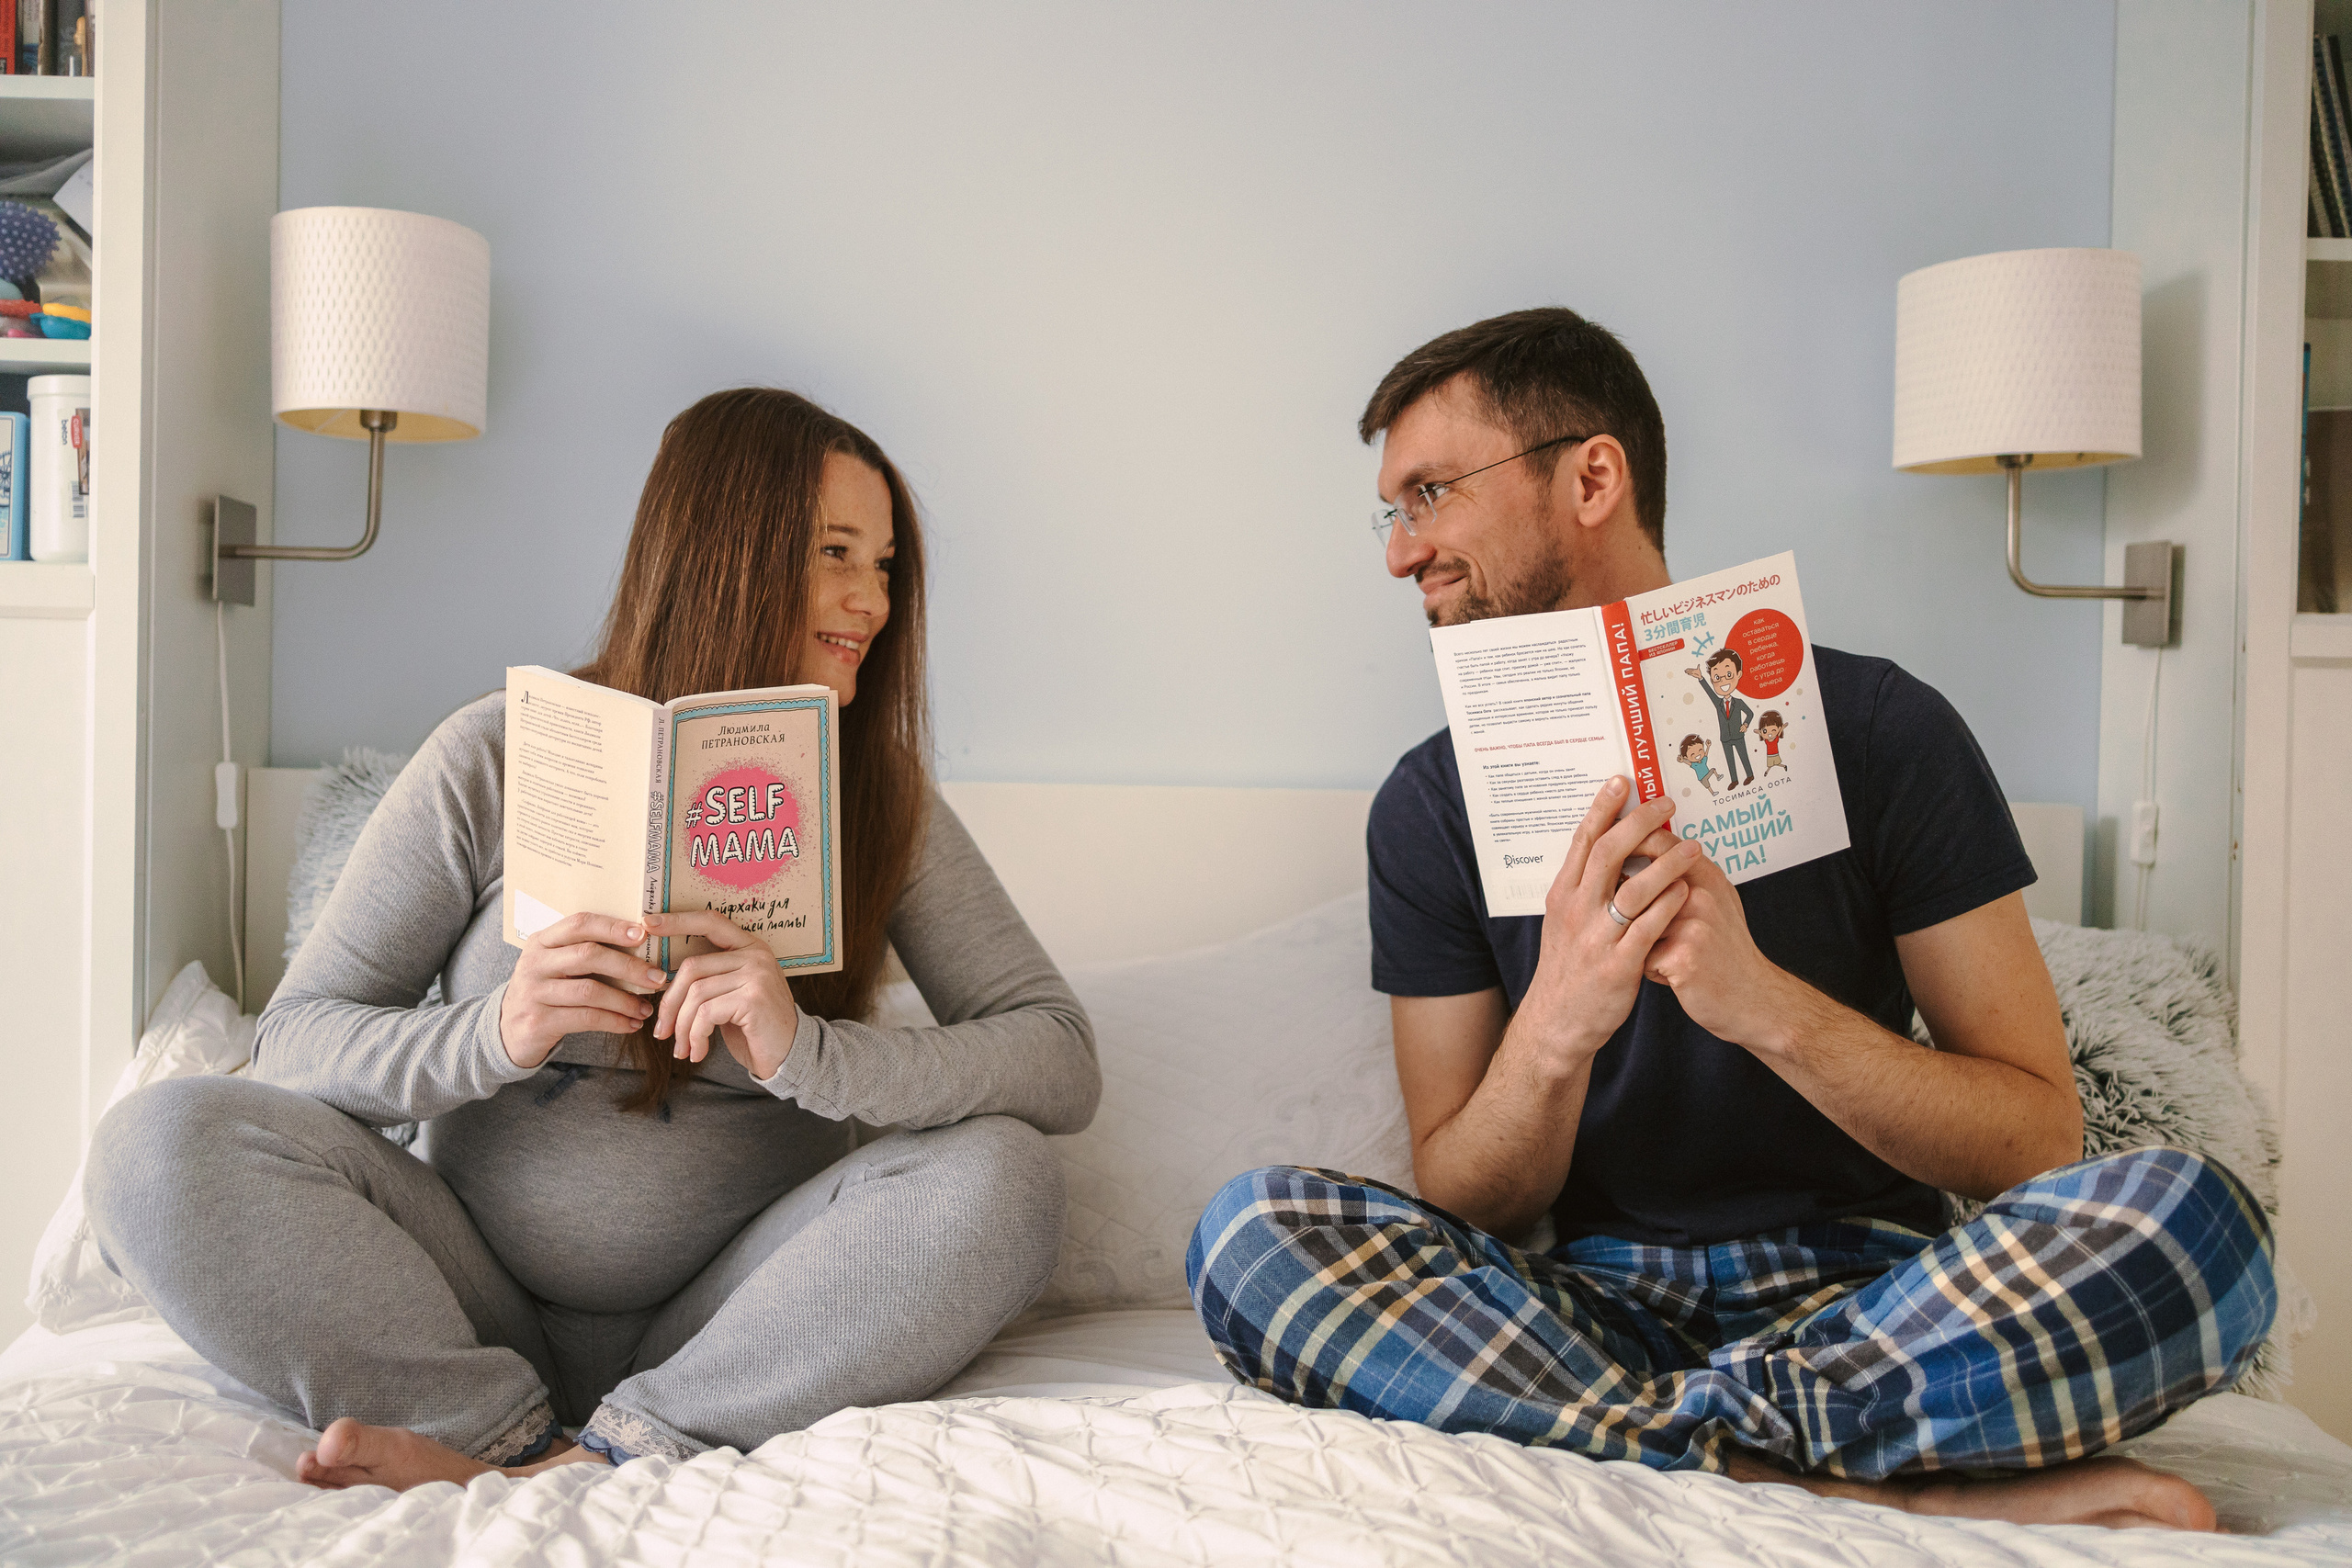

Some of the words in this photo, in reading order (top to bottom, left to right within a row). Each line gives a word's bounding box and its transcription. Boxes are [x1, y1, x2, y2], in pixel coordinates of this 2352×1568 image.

[1641, 574, 1781, 626] 忙しいビジネスマンのための
[1644, 613, 1706, 641] 3分間育児
[1743, 623, 1779, 637] оставаться
[1753, 633, 1777, 643] сердце
[1611, 622, 1634, 678] ПАПА!
[1757, 651, 1775, 660] когда
[1750, 659, 1785, 673] работаешь
[1759, 671, 1774, 679] утра
[1759, 677, 1782, 688] вечера
[718, 724, 770, 736] Людмила
[1621, 683, 1650, 761] ЛУЧШИЙ
[655, 728, 664, 784] ПЕТРАНОВСКАЯ
[701, 734, 786, 750] ПЕТРАНОВСКАЯ
[685, 783, 785, 828] #SELF
[1713, 785, 1763, 806] ТОСИМАСА
[1768, 776, 1792, 788] ООТА
[1682, 793, 1772, 840] САМЫЙ
[647, 790, 663, 873] #SELFMAMA
[1703, 809, 1792, 857] УЧШИЙ
[690, 827, 799, 867] MAMA
[1503, 855, 1544, 868] Discover
[1713, 844, 1766, 874] ПА!
[646, 876, 657, 909] Лайфхаки
[767, 897, 789, 919] для
[767, 915, 806, 931] мамы
